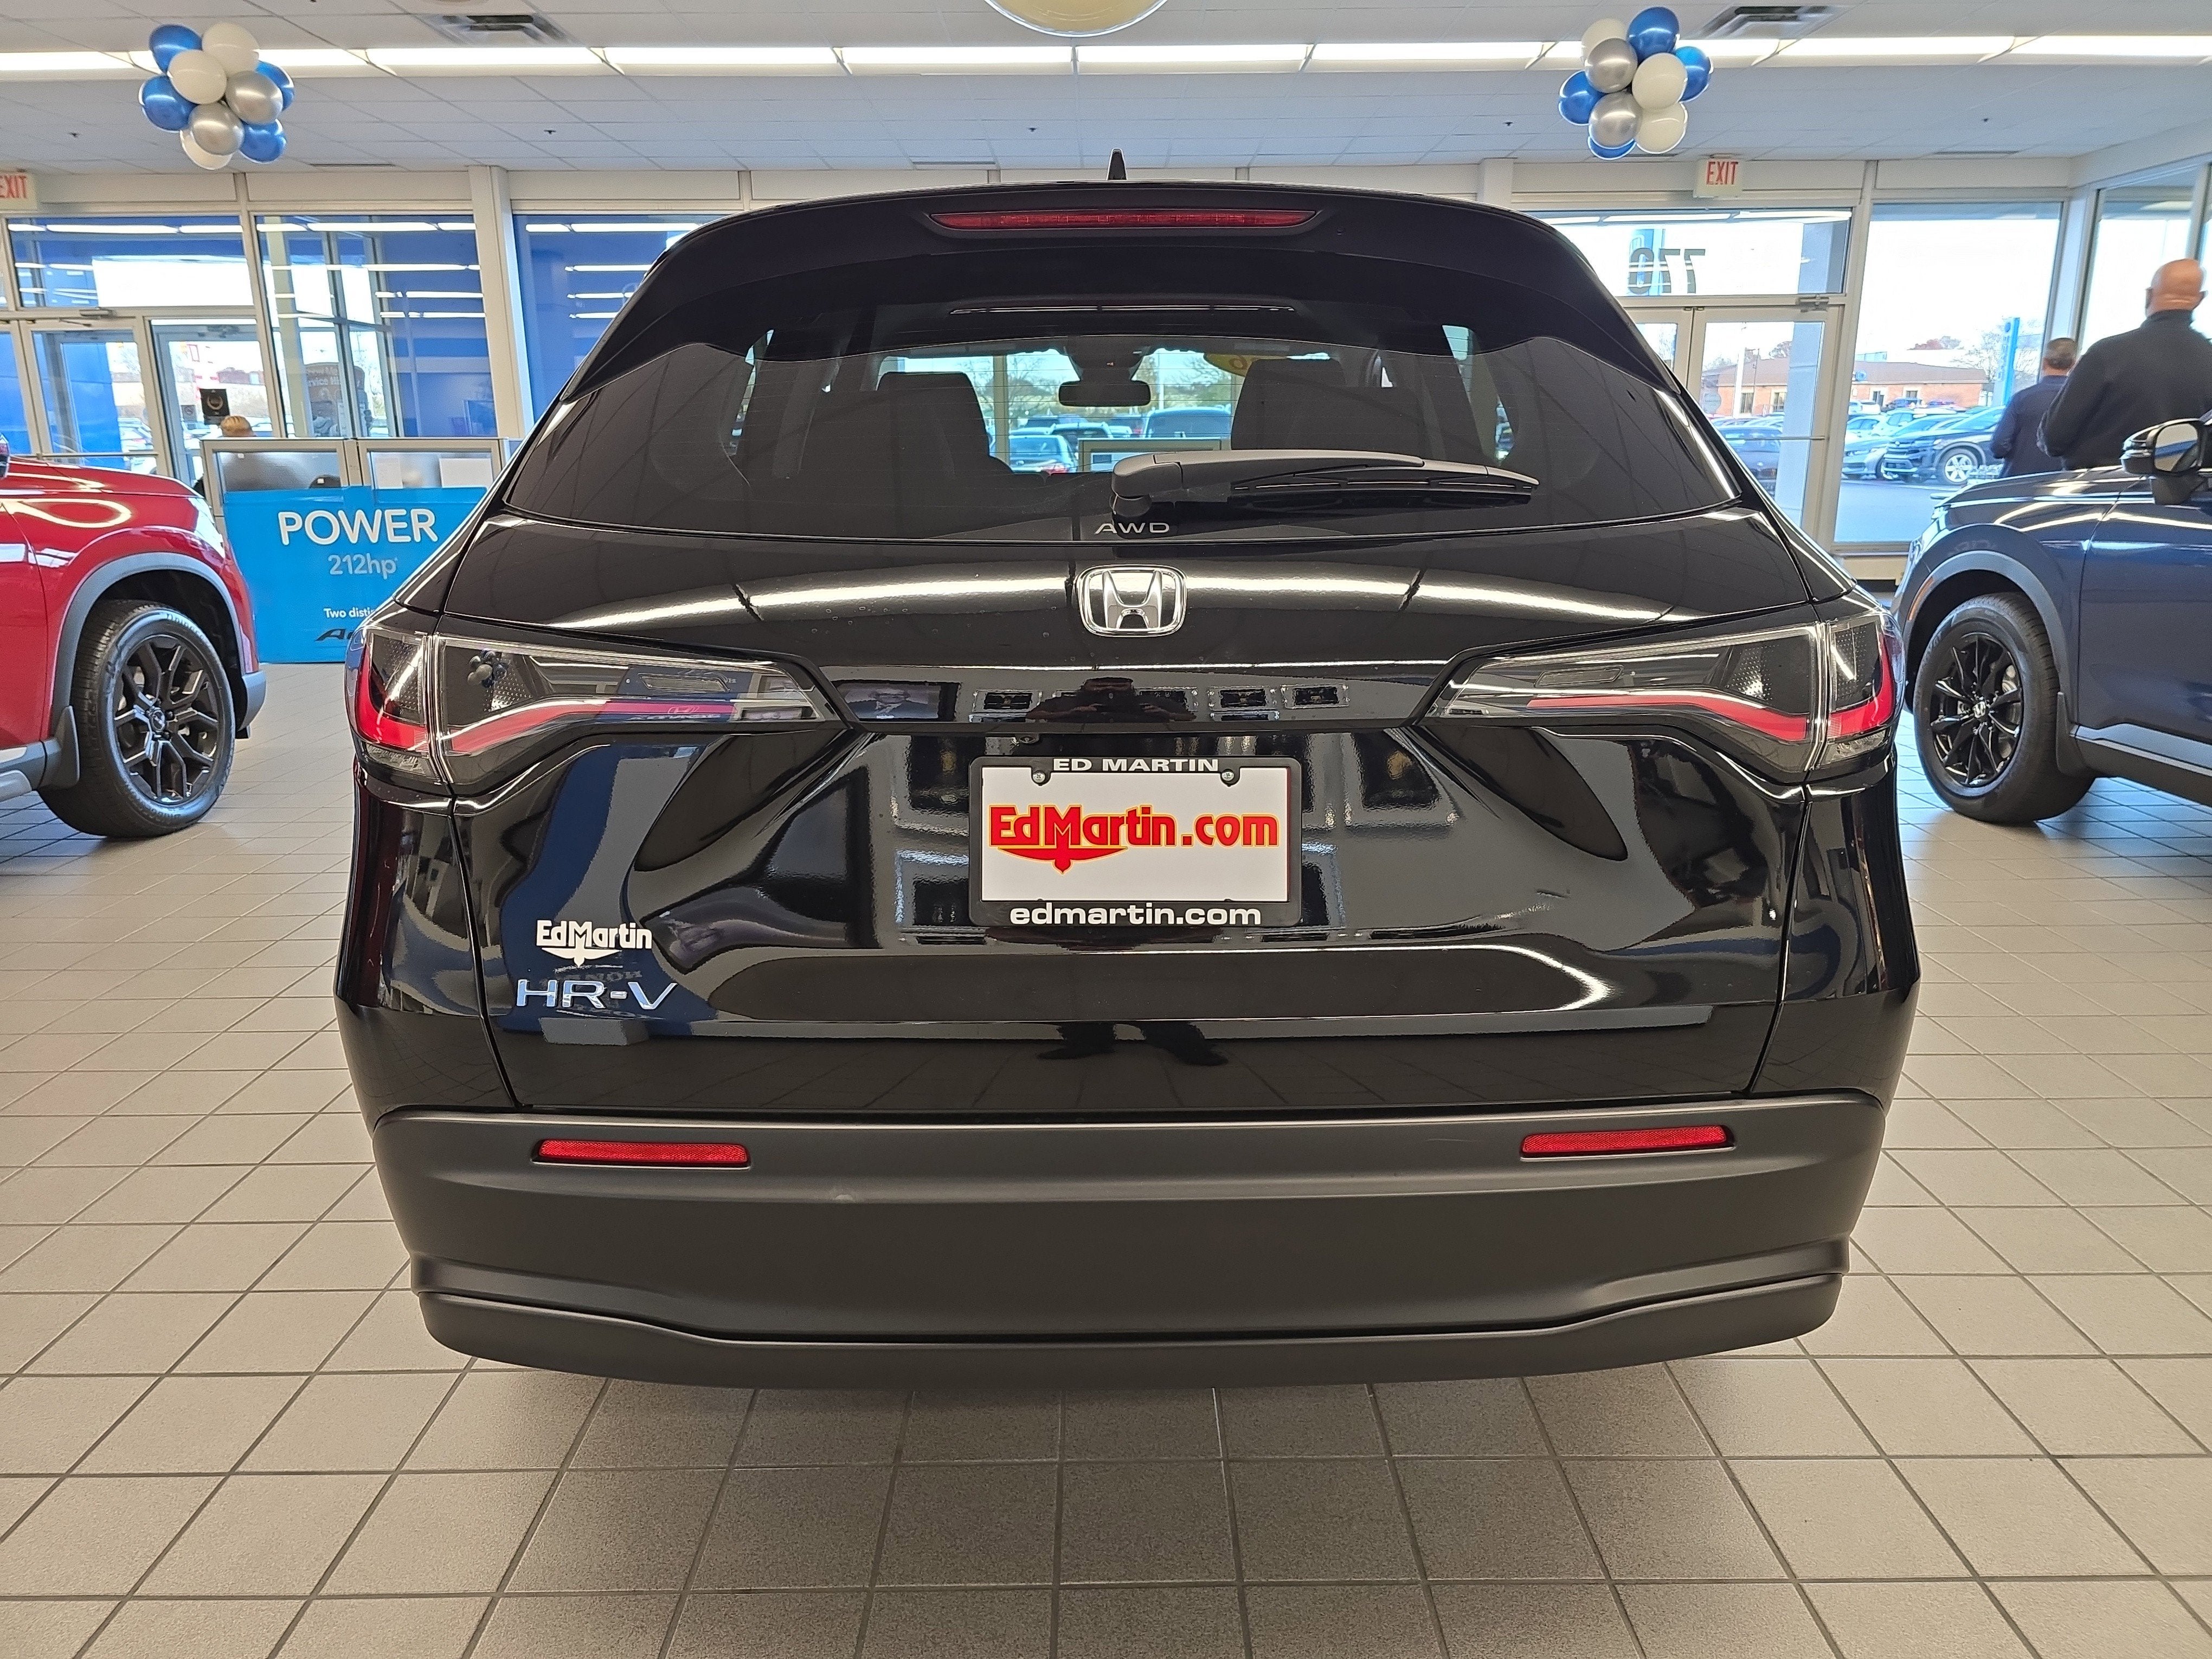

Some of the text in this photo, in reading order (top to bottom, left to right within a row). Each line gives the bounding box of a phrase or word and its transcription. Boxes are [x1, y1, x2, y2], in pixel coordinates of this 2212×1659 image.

[1706, 160, 1739, 185] EXIT
[278, 508, 439, 545] POWER
[1094, 522, 1170, 535] AWD
[323, 608, 347, 618] Two
[1053, 758, 1218, 771] ED MARTIN
[988, 805, 1280, 847] EdMartin.com
[1009, 902, 1261, 925] edmartin.com
[536, 919, 652, 949] EdMartin
[516, 979, 678, 1010] HR-V
